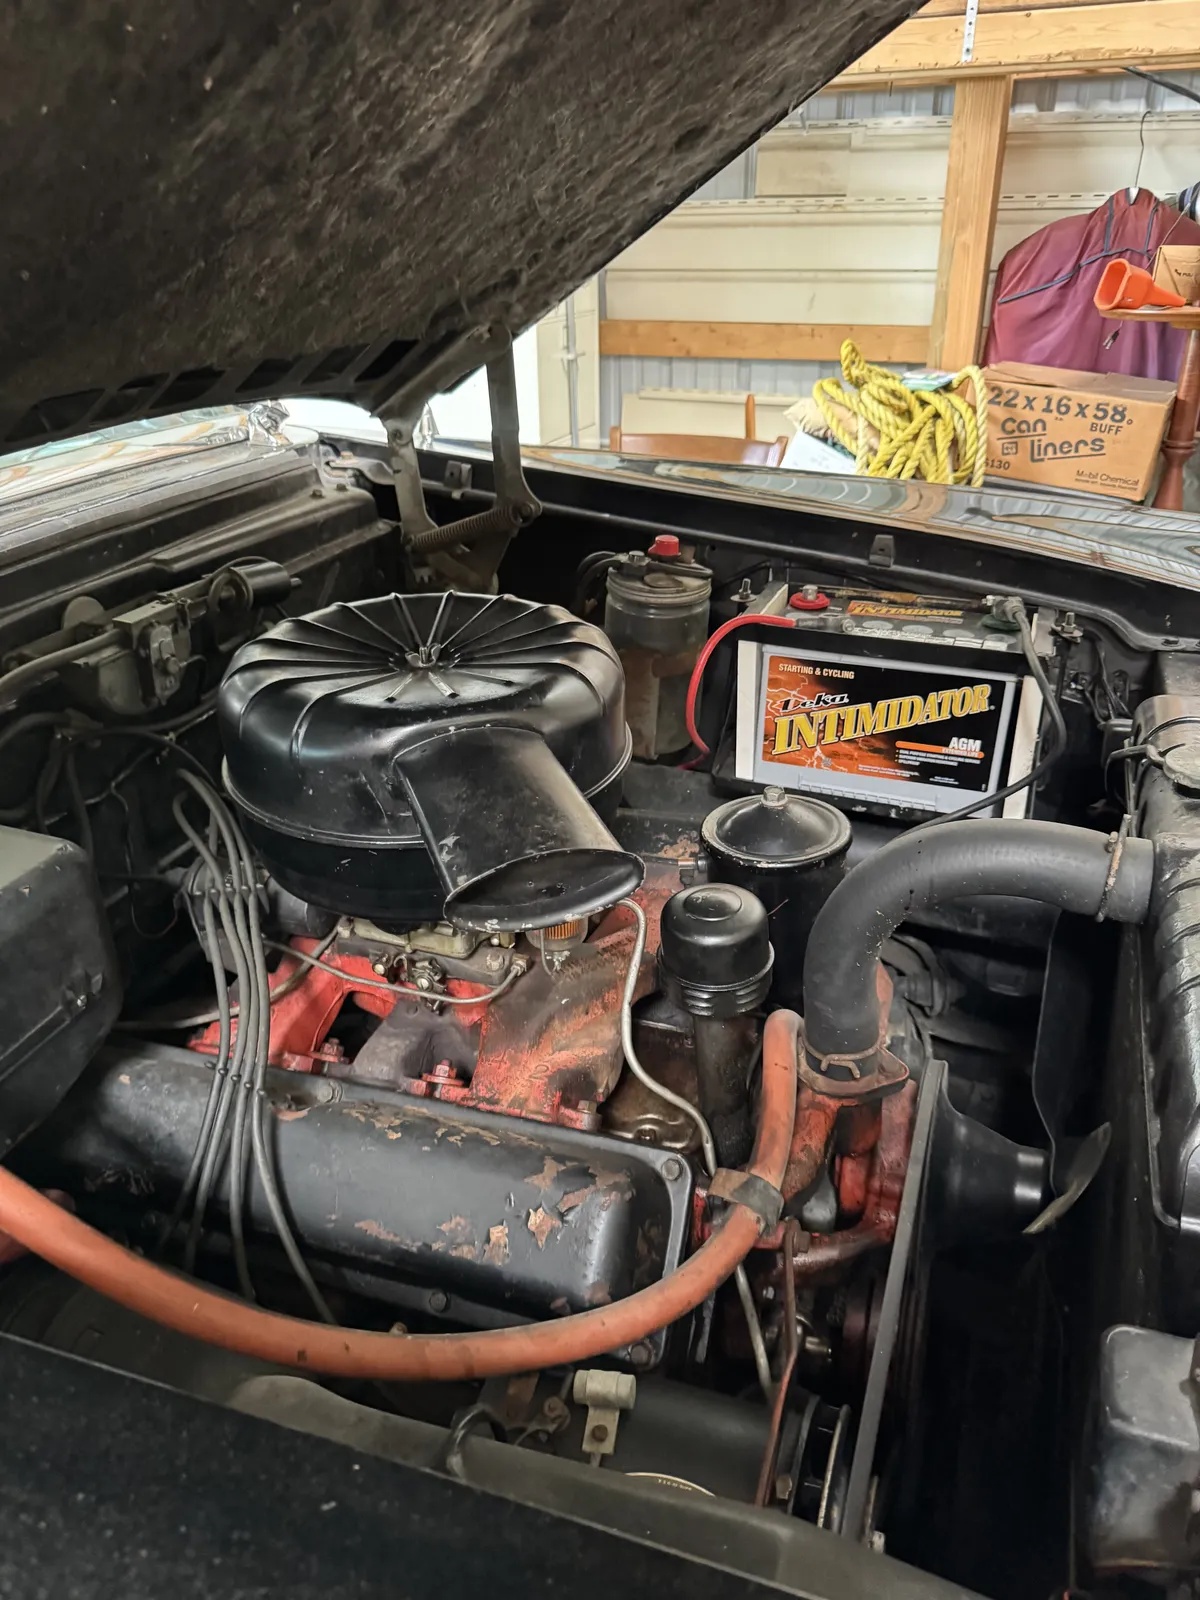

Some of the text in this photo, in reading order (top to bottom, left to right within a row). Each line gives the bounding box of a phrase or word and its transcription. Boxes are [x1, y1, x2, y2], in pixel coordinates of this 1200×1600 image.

[988, 386, 1020, 408] 22
[1022, 395, 1037, 411] x
[1042, 394, 1072, 416] 16
[1075, 402, 1090, 418] x
[1090, 422, 1124, 436] BUFF
[1030, 437, 1106, 463] Liners
[1100, 473, 1140, 487] Chemical
[778, 663, 855, 680] STARTING & CYCLING
[780, 692, 849, 712] Deka
[771, 684, 991, 755] INTIMIDATOR
[948, 736, 982, 752] AGM
